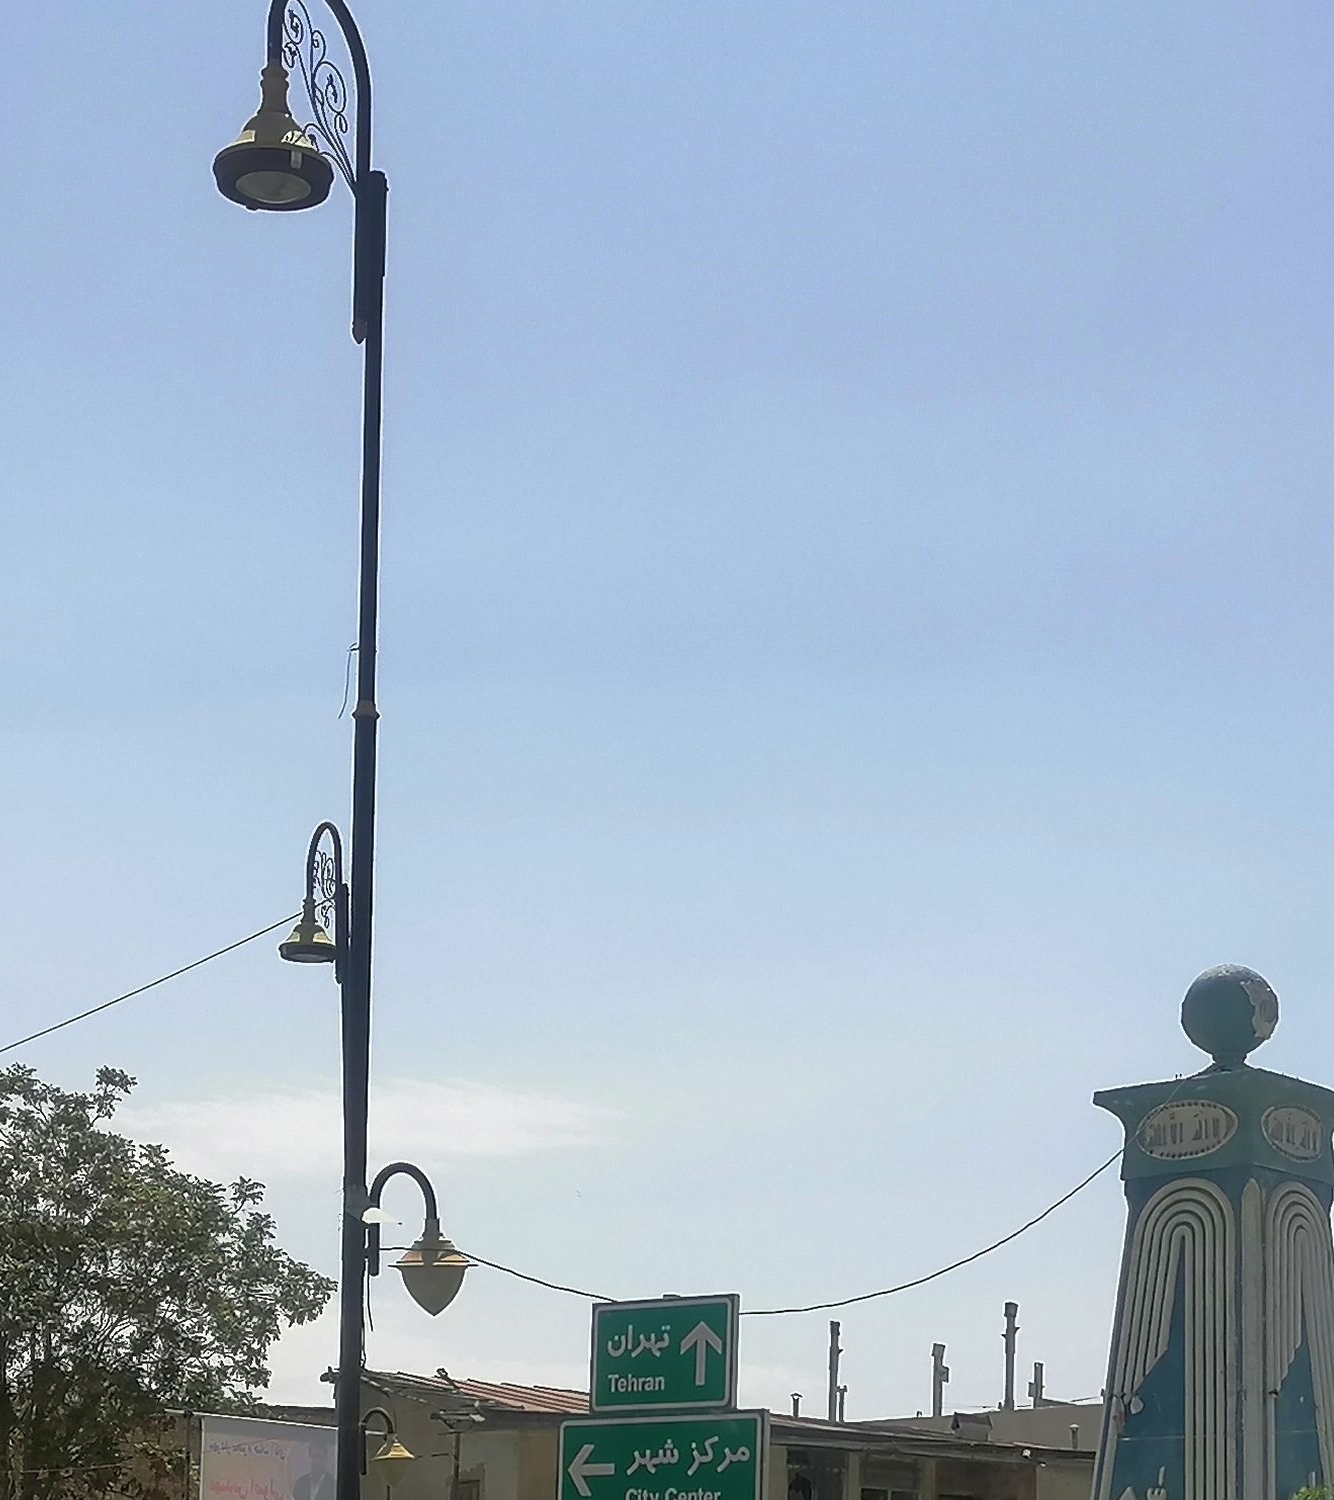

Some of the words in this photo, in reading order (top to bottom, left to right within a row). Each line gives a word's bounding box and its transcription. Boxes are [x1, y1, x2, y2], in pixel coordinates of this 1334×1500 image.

[607, 1324, 671, 1358] تهران
[607, 1374, 665, 1393] Tehran
[626, 1438, 679, 1476] شهر
[687, 1436, 751, 1477] مرکز
